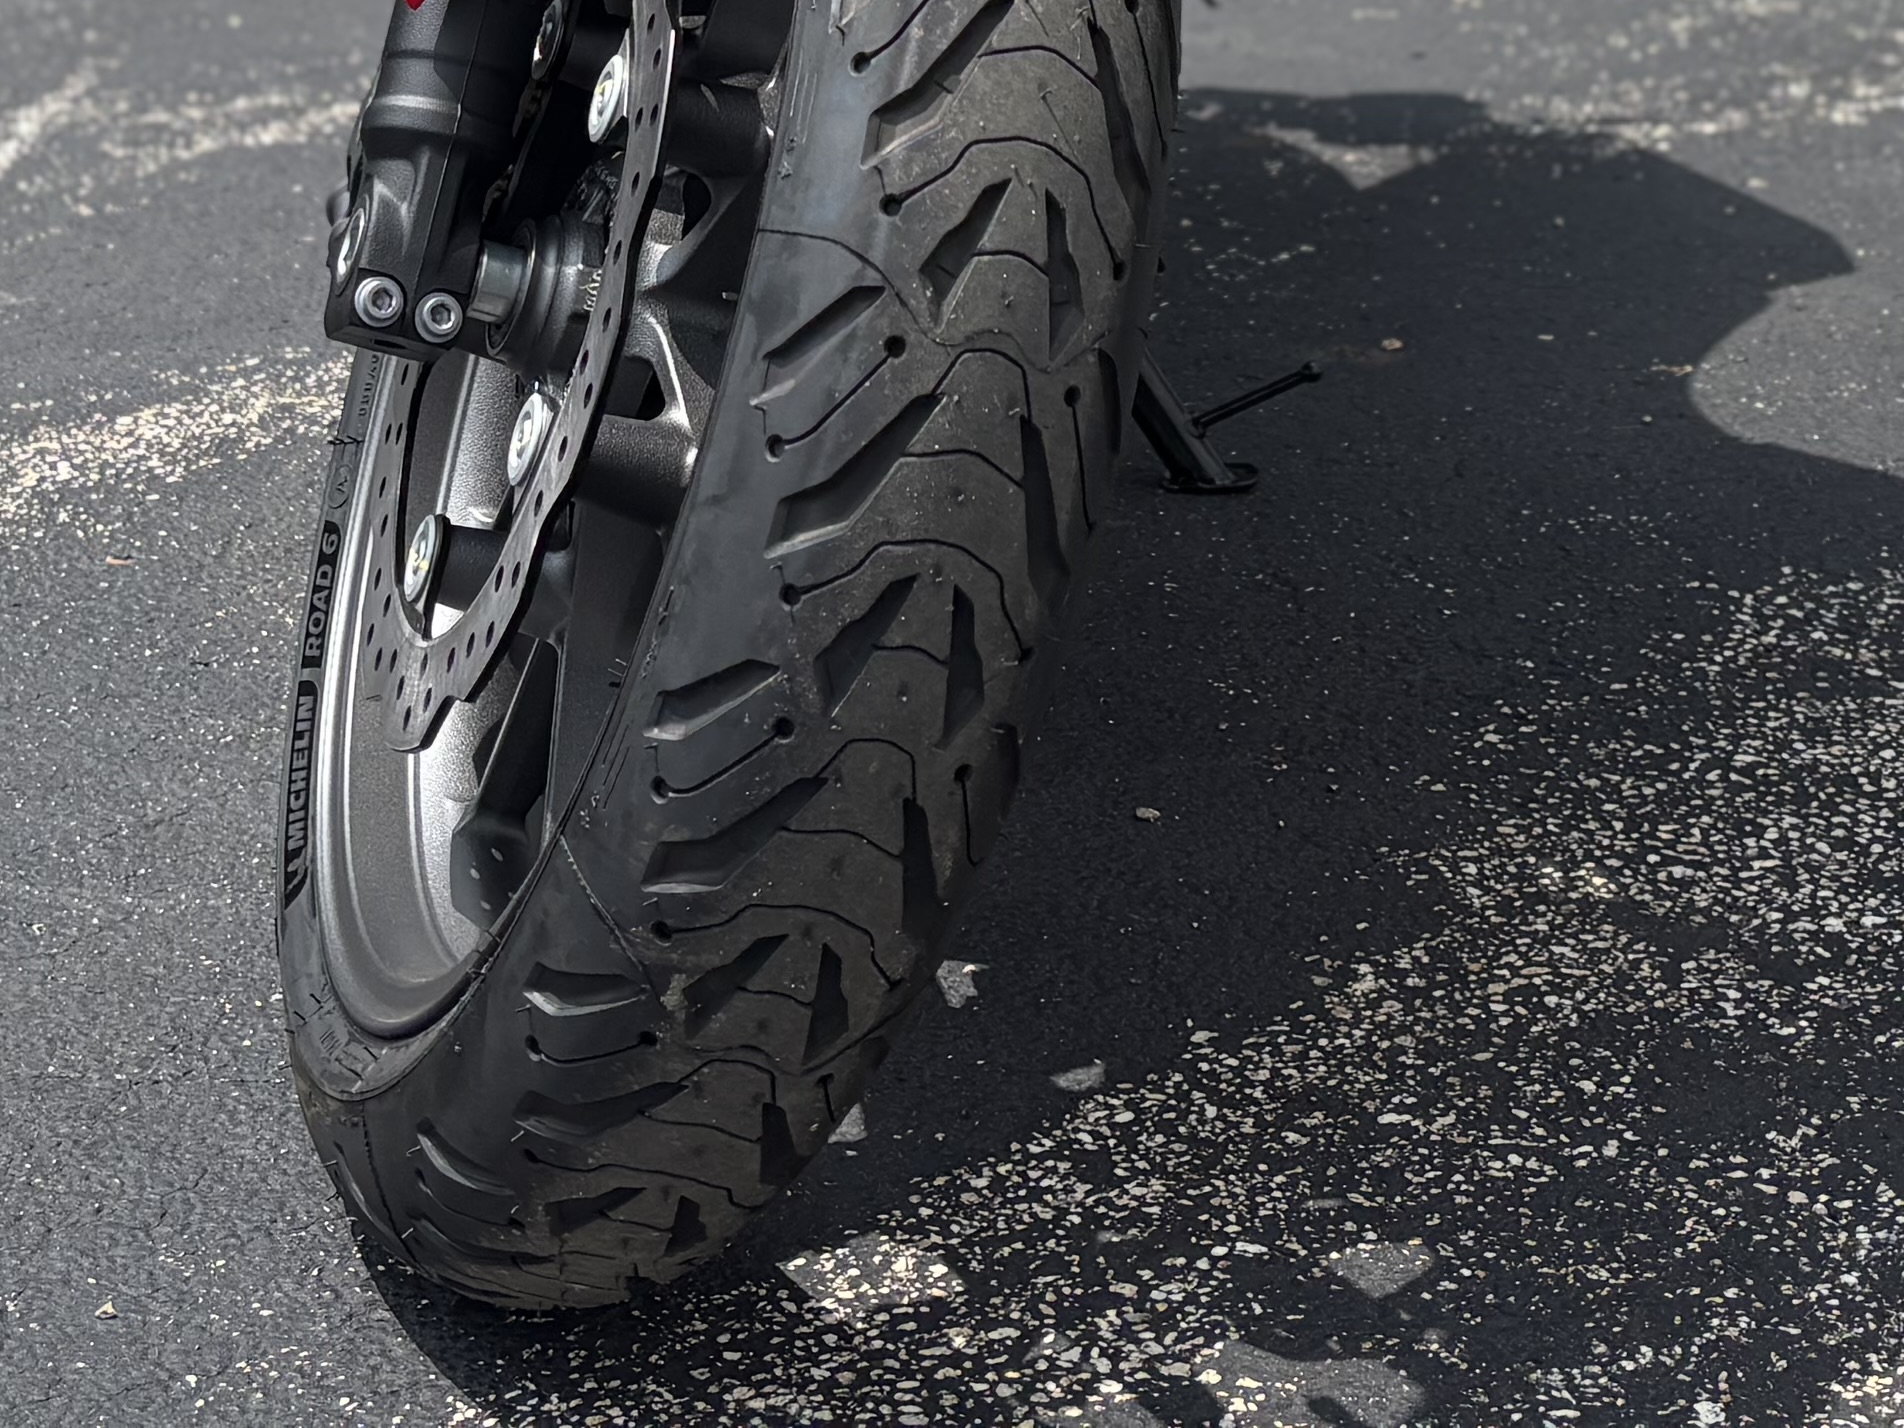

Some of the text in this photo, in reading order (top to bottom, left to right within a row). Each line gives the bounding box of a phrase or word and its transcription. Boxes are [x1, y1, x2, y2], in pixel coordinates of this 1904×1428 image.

[287, 532, 338, 851] MICHELIN ROAD 6
